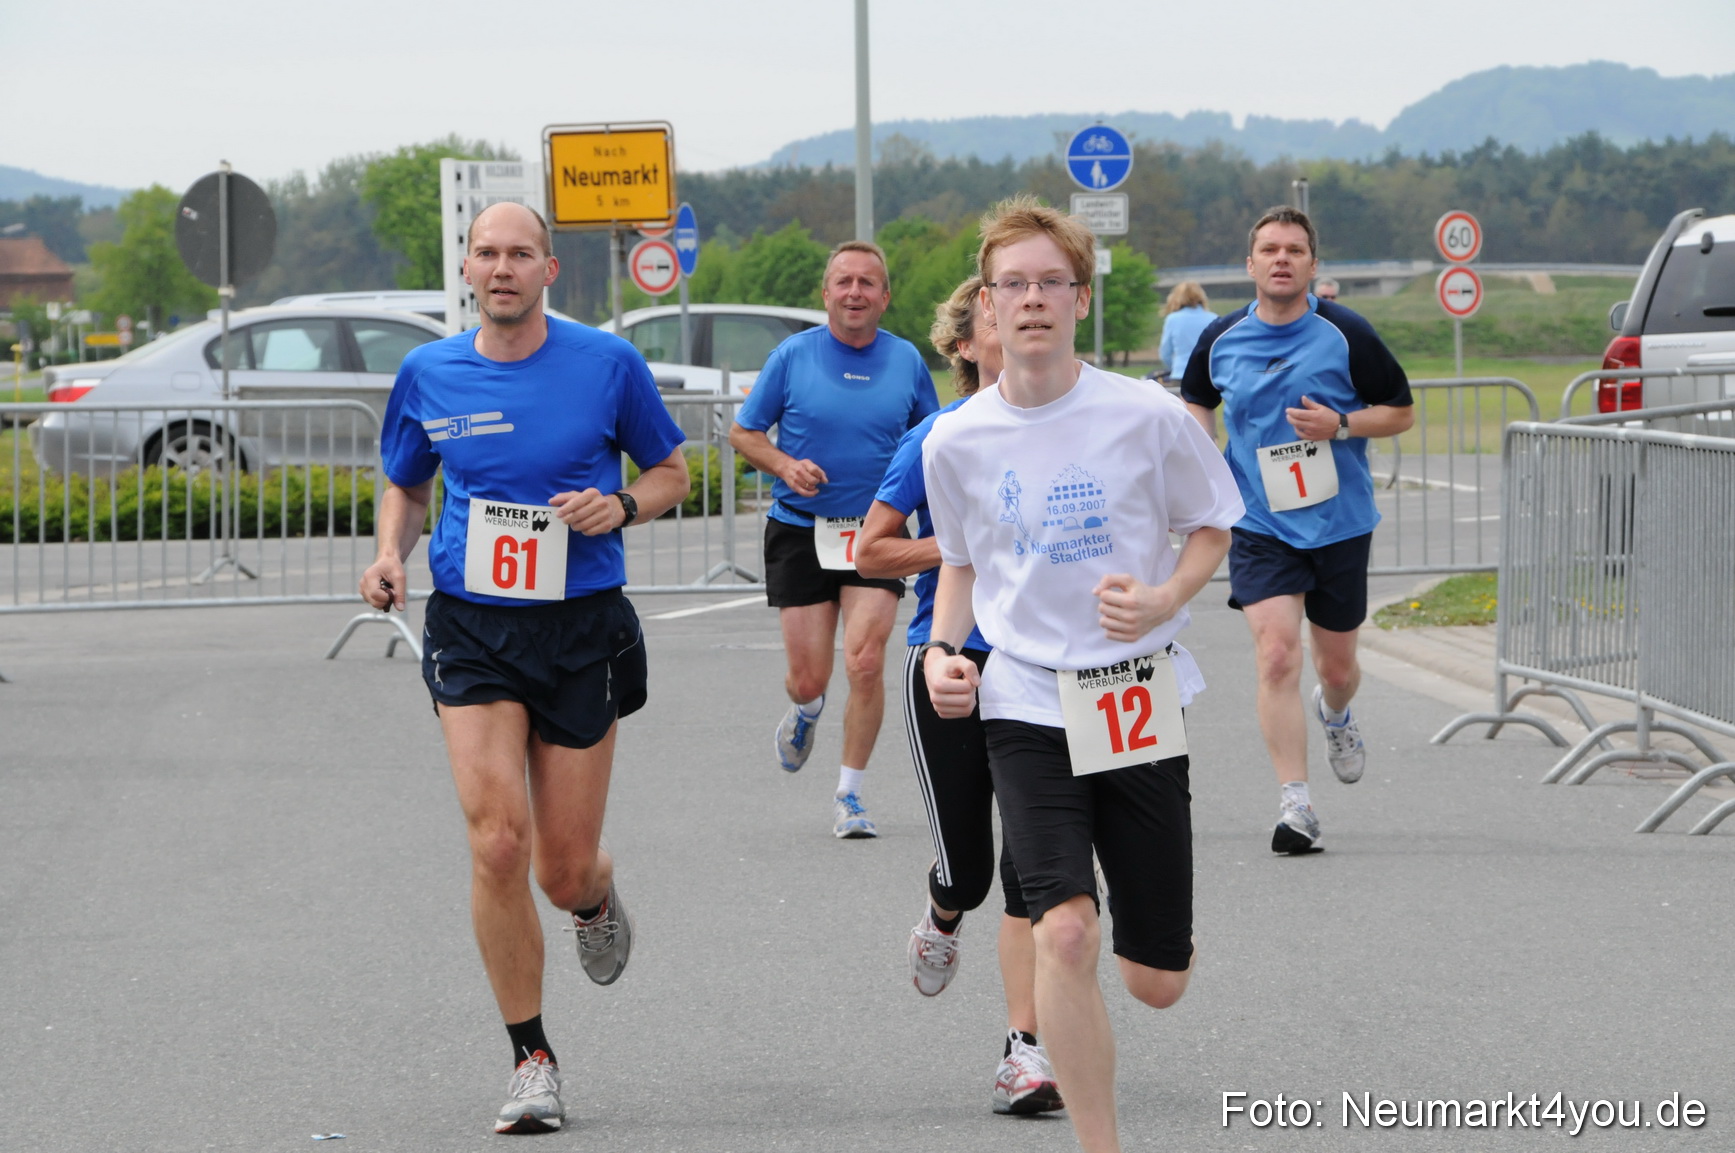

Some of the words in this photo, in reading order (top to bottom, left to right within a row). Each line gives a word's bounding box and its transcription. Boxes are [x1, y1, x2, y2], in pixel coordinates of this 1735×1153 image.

[594, 146, 627, 157] Nach
[562, 163, 658, 187] Neumarkt
[596, 194, 604, 207] 5
[613, 197, 631, 207] km
[1448, 225, 1471, 248] 60
[1270, 444, 1302, 457] MEYER
[1271, 453, 1304, 462] WERBUNG
[1289, 461, 1308, 498] 1
[485, 505, 529, 520] MEYER
[1046, 499, 1106, 515] 16.09.2007
[485, 516, 529, 529] WERBUNG
[827, 521, 858, 529] WERBUNG
[840, 530, 856, 563] 7
[1031, 533, 1111, 554] Neumarkter
[492, 535, 538, 590] 61
[1050, 543, 1113, 564] Stadtlauf
[1077, 660, 1131, 681] MEYER
[1078, 673, 1133, 690] WERBUNG
[1096, 686, 1157, 754] 12
